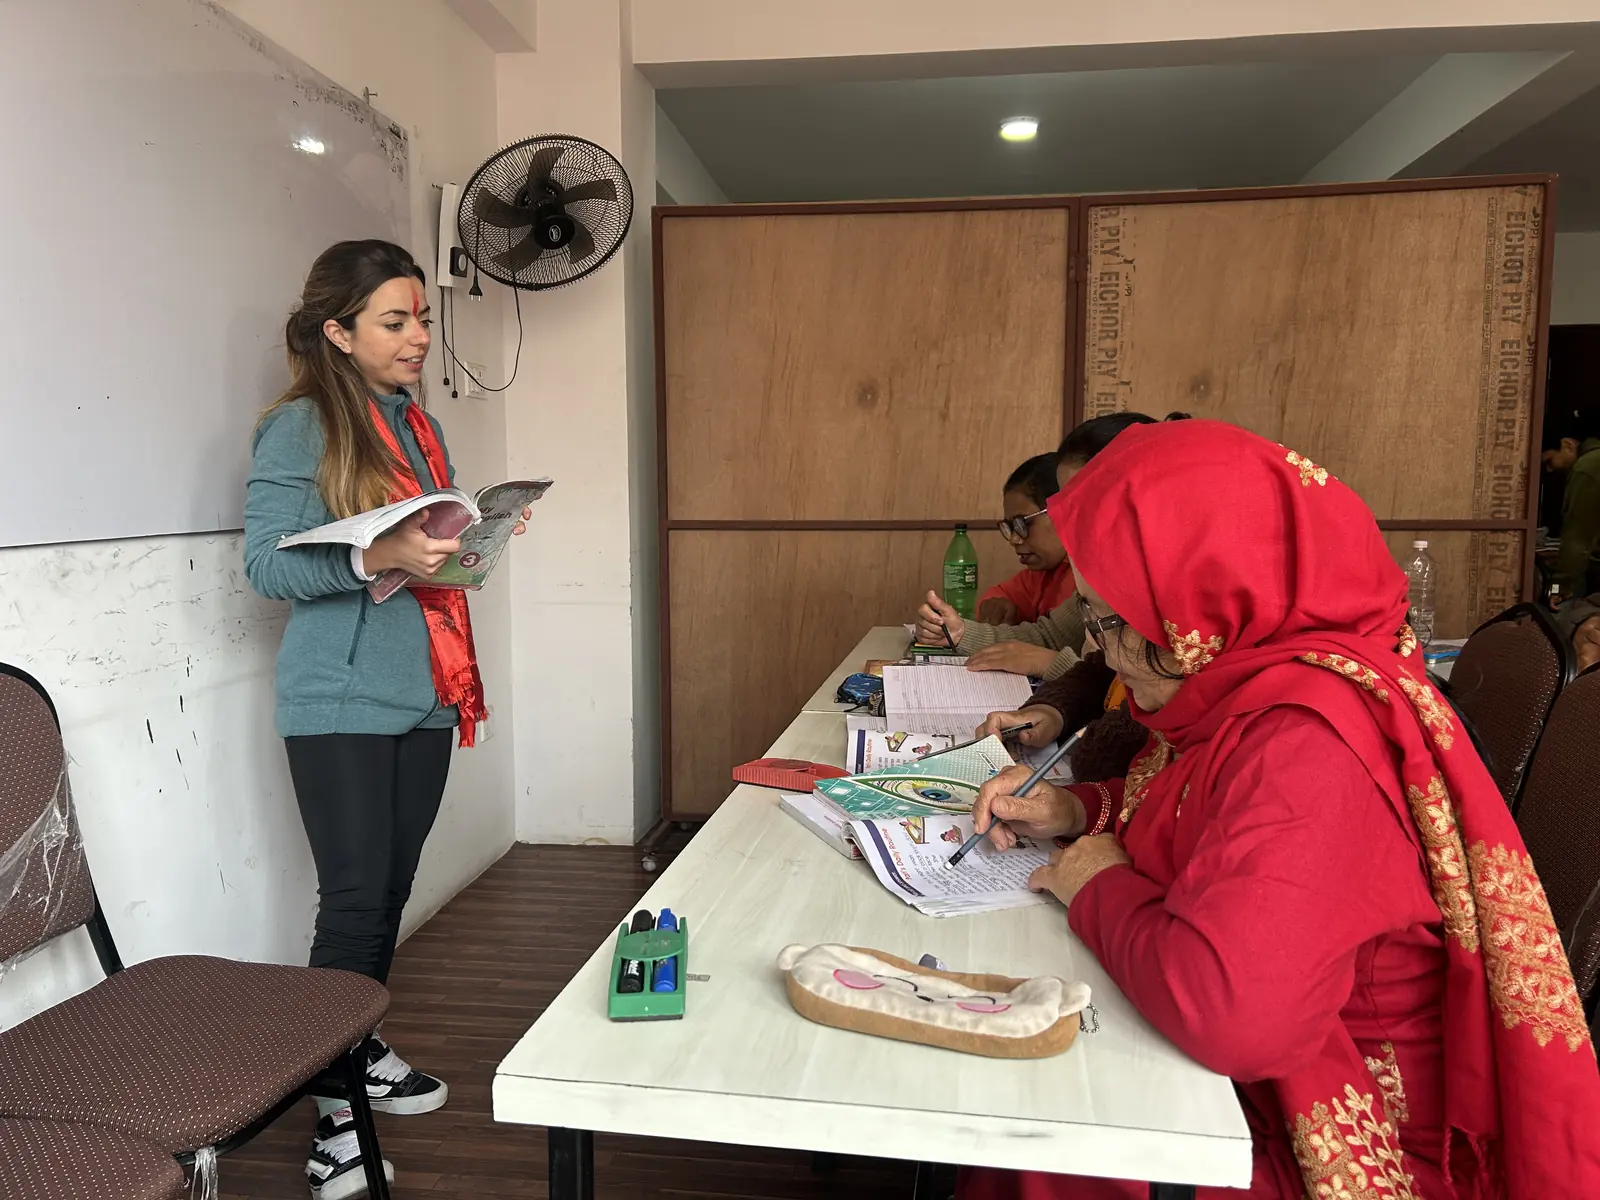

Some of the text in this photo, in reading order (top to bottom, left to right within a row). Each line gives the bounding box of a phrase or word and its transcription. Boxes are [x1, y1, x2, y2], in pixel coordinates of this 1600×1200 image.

[1100, 226, 1120, 258] PLY
[1530, 219, 1540, 239] PPI
[1502, 211, 1527, 284] EICHOR
[1097, 271, 1120, 379] EICHOR PLY
[1501, 292, 1524, 326] PLY
[1494, 339, 1521, 451] EICHOR PLY
[462, 554, 477, 566] 3
[1488, 542, 1511, 575] PLY
[881, 826, 895, 851] Routine
[891, 850, 904, 867] Daily
